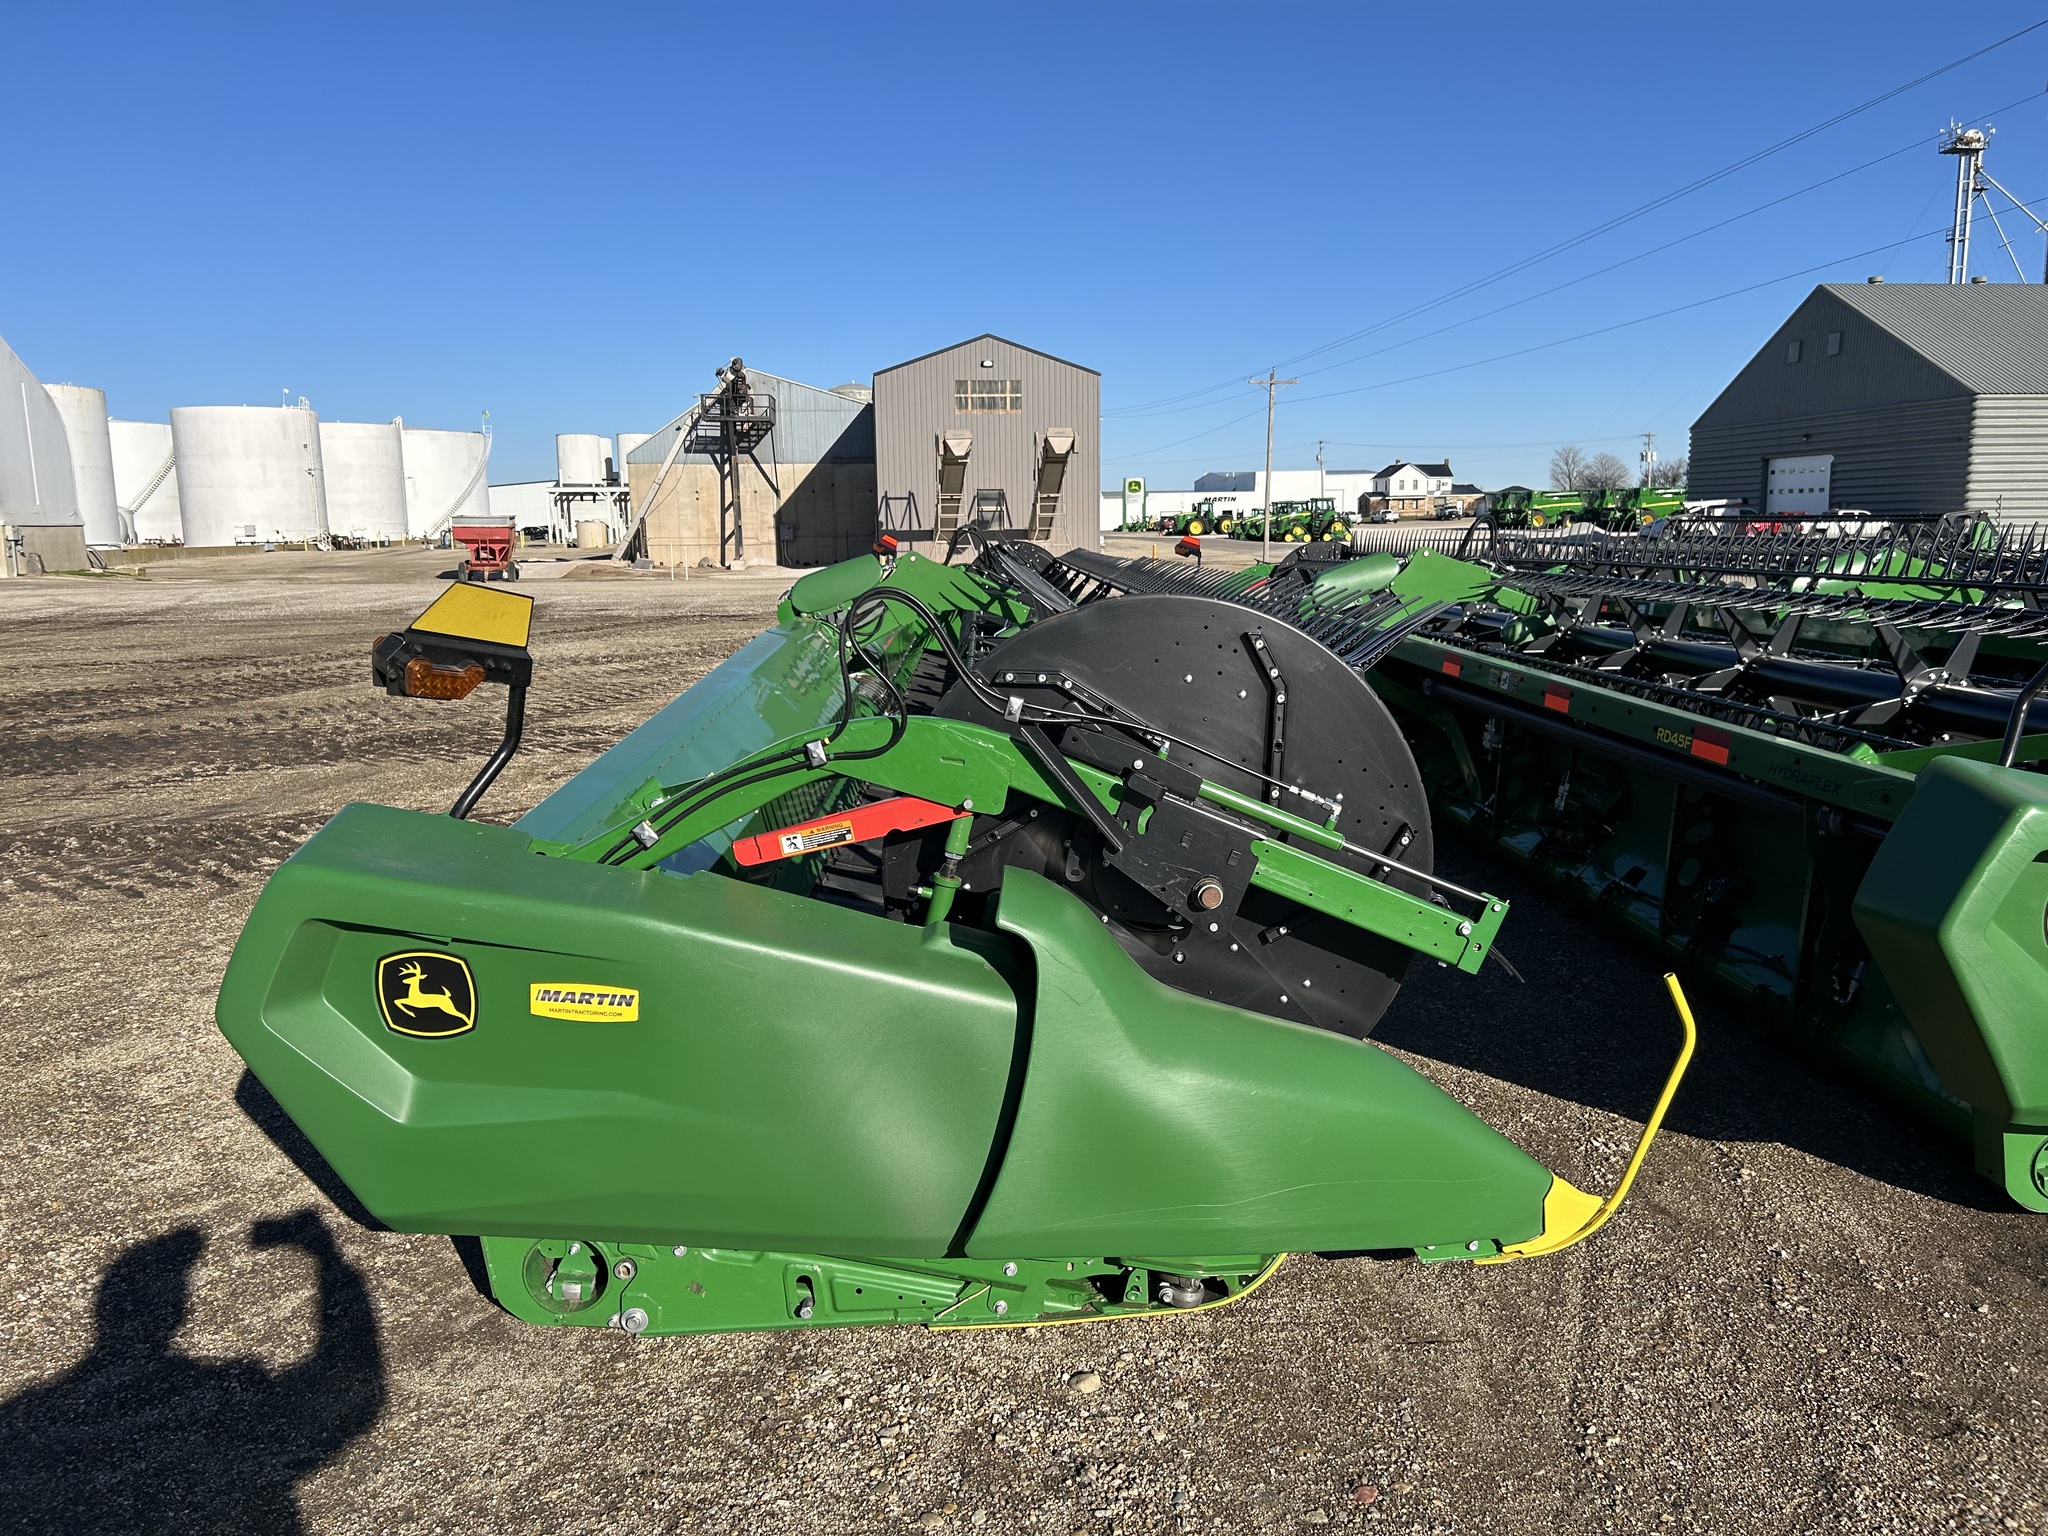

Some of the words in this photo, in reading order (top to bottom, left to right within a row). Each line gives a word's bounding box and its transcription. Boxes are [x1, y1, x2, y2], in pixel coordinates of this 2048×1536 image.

[1656, 727, 1692, 750] RD45F
[1768, 764, 1841, 796] HYDRAFLEX
[816, 822, 843, 833] WARNING
[537, 989, 635, 1007] MARTIN
[548, 1007, 622, 1017] MARTINTRACTORINC.COM
